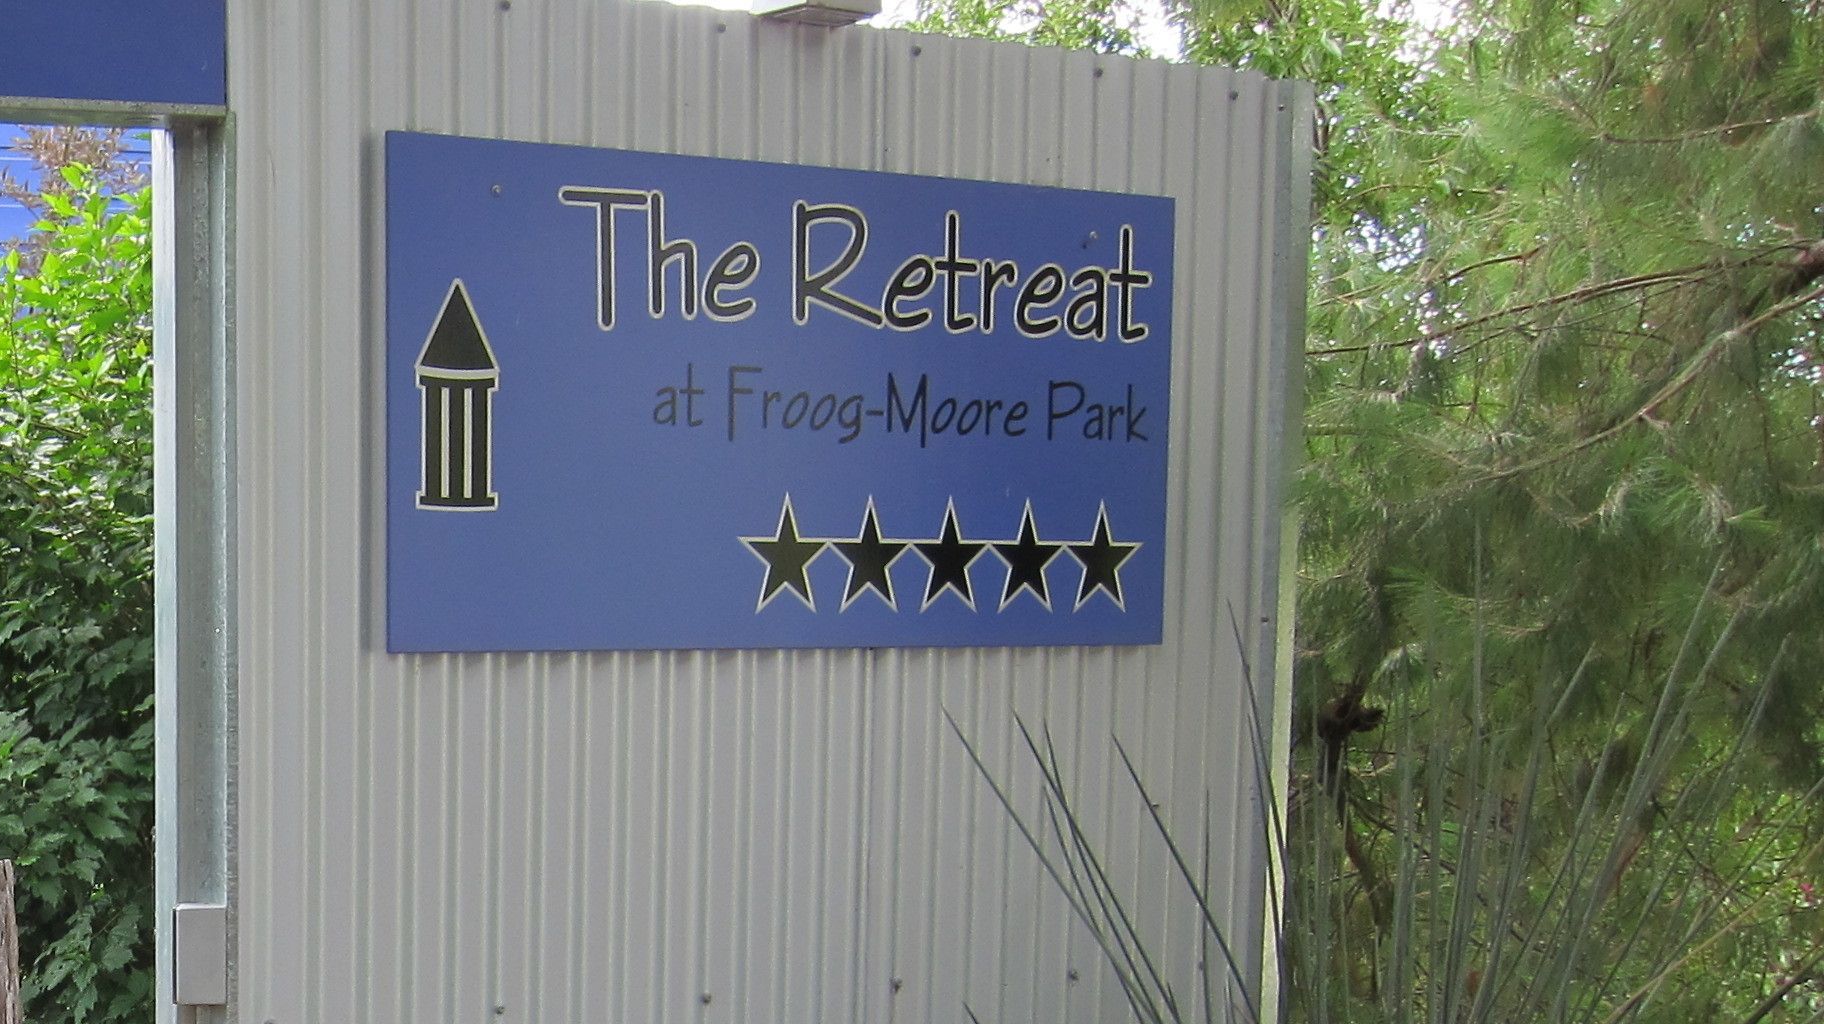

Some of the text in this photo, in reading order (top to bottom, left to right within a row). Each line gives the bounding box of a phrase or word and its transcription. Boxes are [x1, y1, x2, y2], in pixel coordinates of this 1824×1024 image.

[558, 184, 1153, 344] The Retreat
[652, 362, 1149, 447] at Froog-Moore Park
